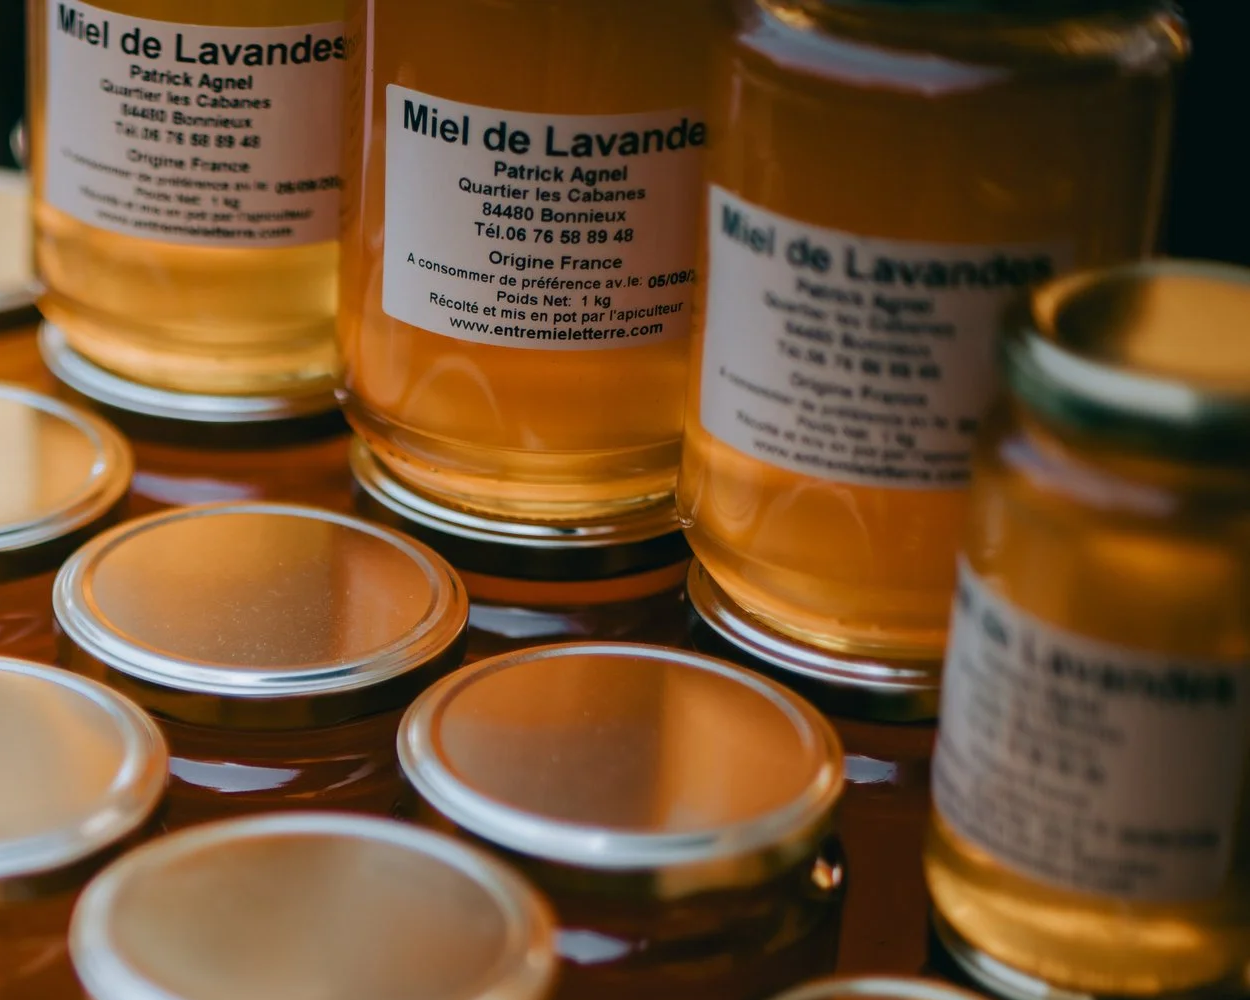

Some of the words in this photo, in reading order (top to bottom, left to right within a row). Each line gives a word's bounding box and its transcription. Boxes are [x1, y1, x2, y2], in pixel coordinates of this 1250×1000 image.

[58, 4, 109, 48] Miel
[121, 27, 162, 59] de
[176, 34, 348, 66] Lavandes
[130, 64, 193, 87] Patrick
[198, 73, 253, 93] Agnel
[167, 91, 190, 106] les
[196, 94, 272, 109] Cabanes
[173, 111, 253, 129] Bonnieux
[403, 99, 470, 146] Miel
[483, 120, 531, 155] de
[494, 160, 564, 183] Patrick
[570, 164, 628, 187] Agnel
[458, 177, 530, 201] Quartier
[535, 187, 562, 203] les
[567, 187, 646, 204] Cabanes
[482, 201, 534, 221] 84480
[541, 207, 627, 224] Bonnieux
[474, 221, 527, 242] Tél.06
[533, 229, 554, 244] 76
[560, 230, 581, 245] 58
[587, 229, 608, 244] 89
[613, 227, 634, 244] 48
[488, 250, 555, 271] Origine
[560, 255, 623, 270] France
[786, 235, 832, 274] de
[407, 252, 416, 264] A
[418, 257, 496, 285] consommer
[499, 274, 517, 287] de
[521, 276, 601, 291] préférence
[429, 291, 479, 314] Récolté
[482, 305, 497, 317] et
[500, 307, 526, 321] mis
[530, 313, 548, 323] en
[553, 311, 578, 325] pot
[581, 312, 605, 325] par
[609, 301, 684, 323] l'apiculteur
[496, 290, 538, 305] Poids
[543, 295, 572, 307] Net:
[582, 295, 588, 307] 1
[594, 295, 611, 309] kg
[449, 316, 663, 341] www.entremieletterre.com
